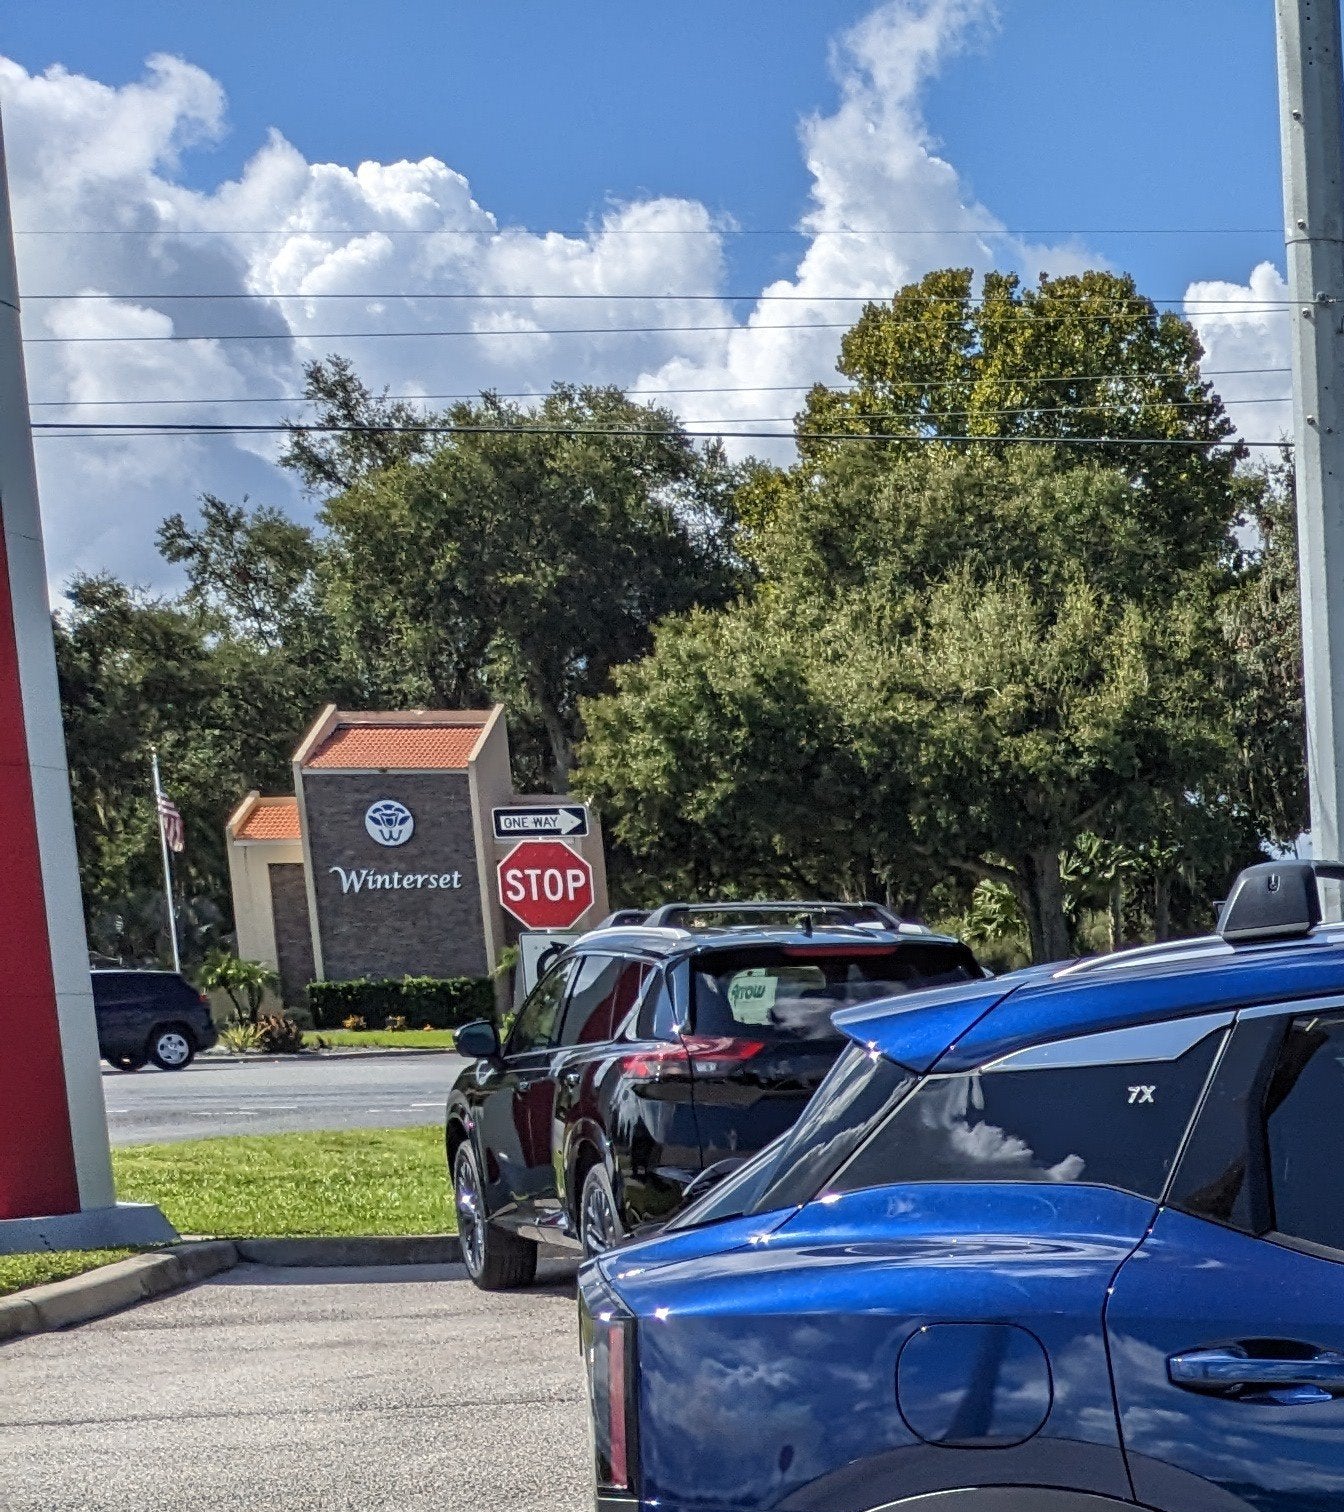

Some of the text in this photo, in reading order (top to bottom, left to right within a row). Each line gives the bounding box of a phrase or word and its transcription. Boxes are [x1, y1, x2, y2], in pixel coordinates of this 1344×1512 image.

[504, 816, 558, 829] ONE WAY
[329, 866, 462, 894] Winterset
[506, 868, 585, 902] STOP
